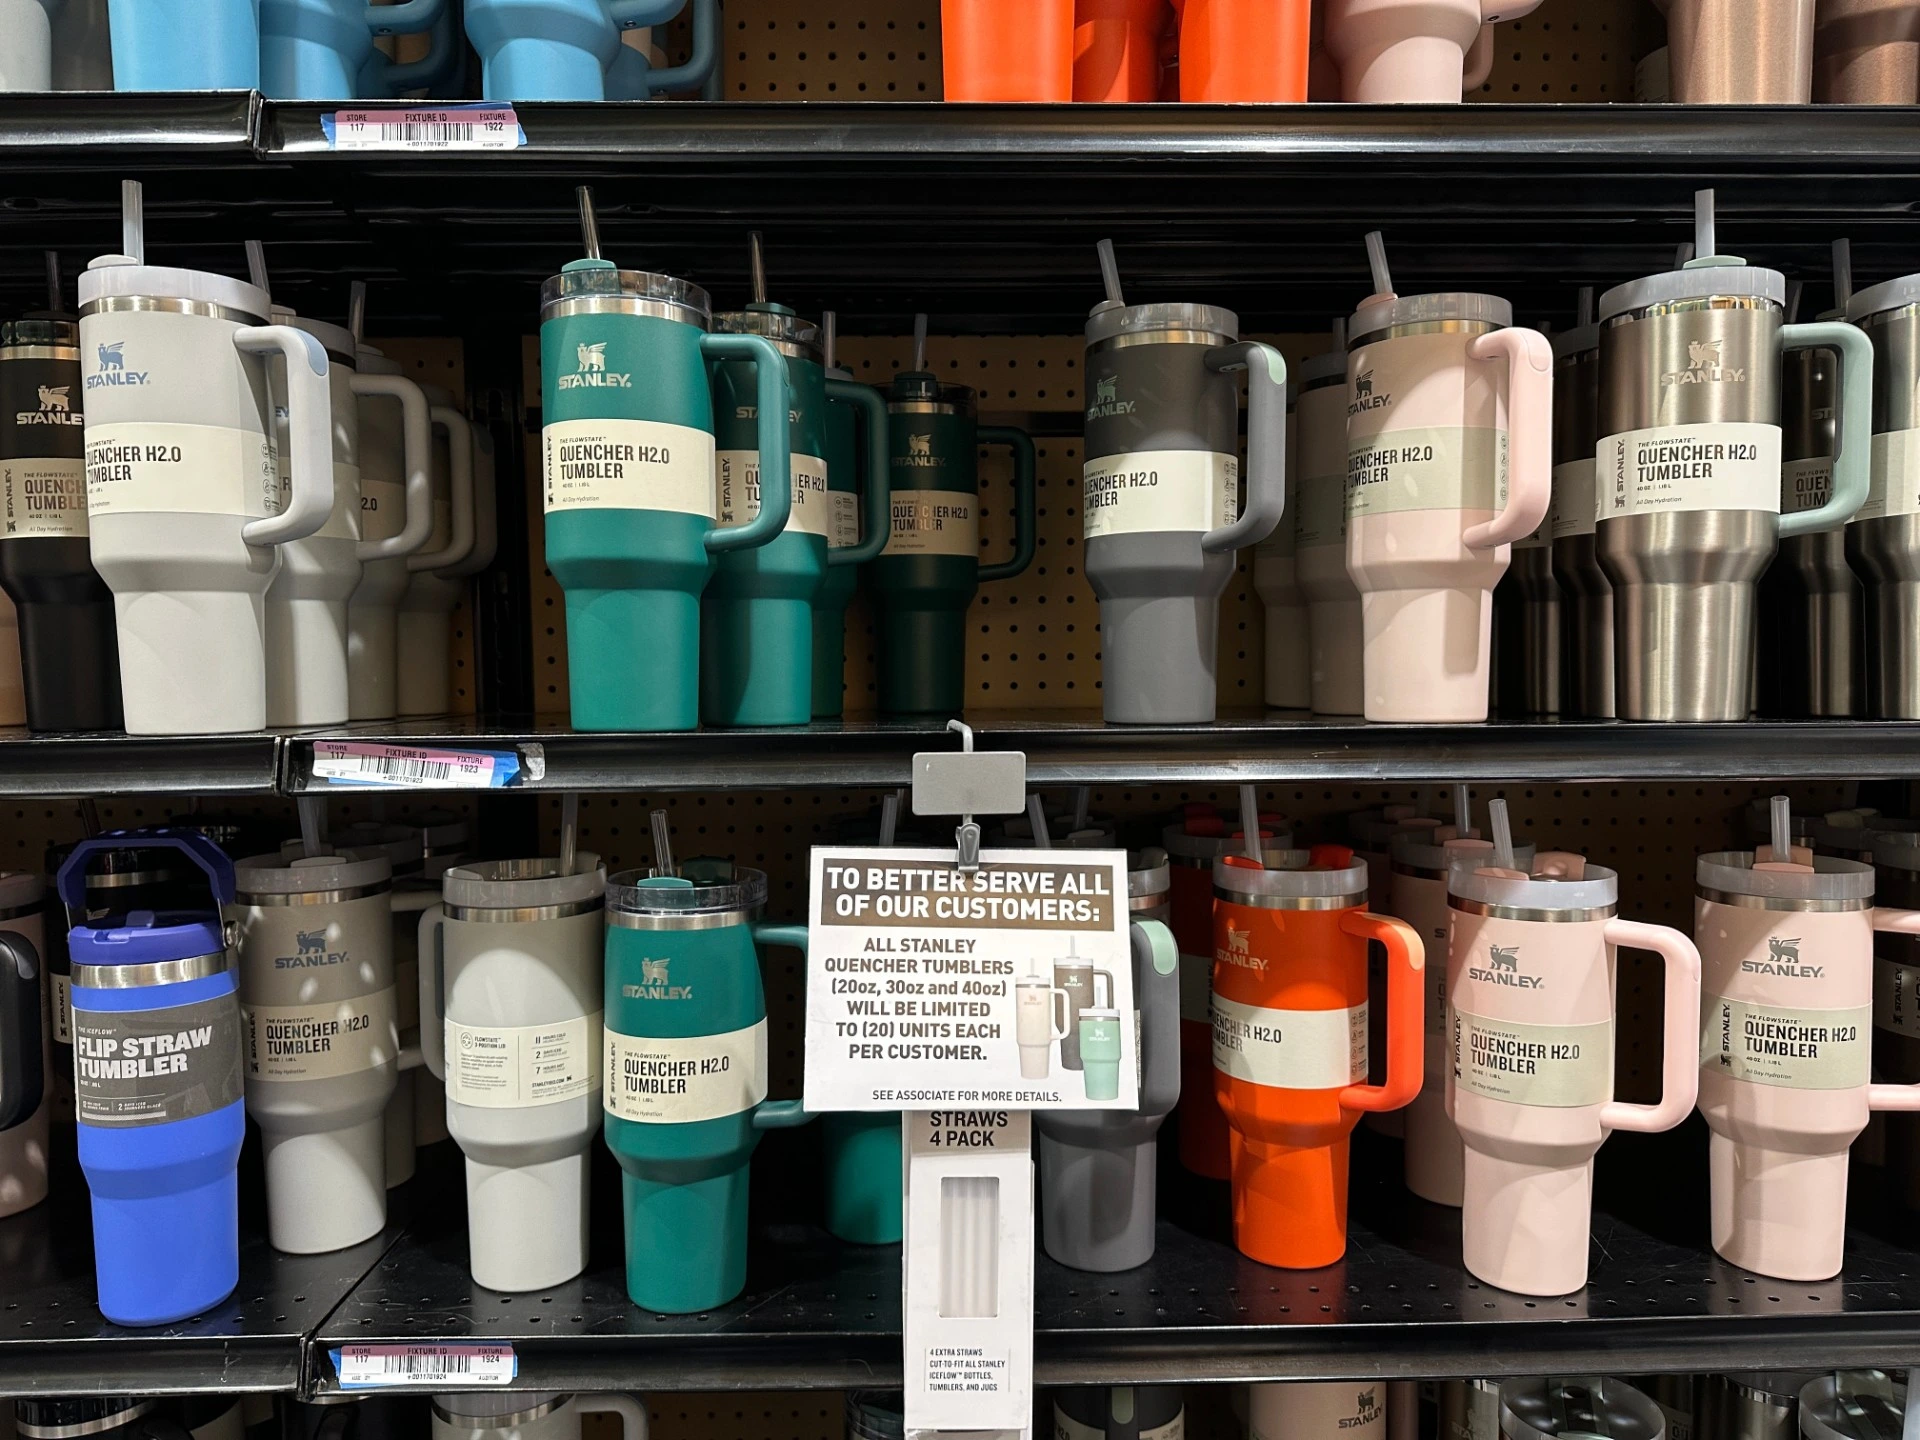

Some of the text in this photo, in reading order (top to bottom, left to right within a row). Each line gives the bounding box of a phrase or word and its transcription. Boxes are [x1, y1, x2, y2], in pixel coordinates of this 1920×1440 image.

[484, 123, 503, 131] 1922
[146, 446, 181, 462] H2.0
[560, 445, 669, 464] QUENCHER H2.0
[1402, 446, 1432, 462] H2.0
[1638, 444, 1756, 465] QUENCHER H2.0
[561, 463, 623, 480] TUMBLER
[1130, 471, 1157, 487] H2.0
[1638, 462, 1712, 483] TUMBLER
[25, 480, 86, 494] QUENCH
[25, 496, 86, 510] TUMBLE
[361, 498, 377, 511] 2.0
[386, 749, 417, 758] FIXTURE
[457, 756, 483, 764] FIXTURE
[460, 765, 478, 773] 1923
[827, 867, 1110, 896] TO BETTER SERVE ALL
[836, 894, 1100, 922] OF OUR CUSTOMERS:
[864, 938, 976, 953] ALL STANLEY
[825, 958, 1014, 975] QUENCHER TUMBLERS
[832, 979, 1006, 997] (20oz, 30oz and 40oz)
[847, 1001, 990, 1017] WILL BE LIMITED
[266, 1015, 369, 1039] QUENCHER H2.0
[836, 1022, 1001, 1039] TO (20) UNITS EACH
[1254, 1026, 1281, 1043] H2.0
[1745, 1021, 1856, 1042] QUENCHER H2.0
[79, 1026, 212, 1058] FLIP STRAW
[267, 1038, 330, 1054] TUMBLER
[1471, 1033, 1580, 1060] QUENCHER H2.0
[1744, 1036, 1817, 1058] TUMBLER
[536, 1051, 540, 1059] 2
[849, 1045, 988, 1060] PER CUSTOMER.
[79, 1053, 188, 1079] TUMBLER
[625, 1056, 729, 1076] QUENCHER H2.0
[1471, 1050, 1535, 1075] TUMBLER
[624, 1075, 686, 1094] TUMBLER
[872, 1090, 1062, 1102] SEE ASSOCIATE FOR MORE DETAILS.
[930, 1111, 1008, 1128] STRAWS
[930, 1131, 995, 1147] 4 PACK
[355, 1355, 368, 1363] 117
[929, 1360, 1005, 1368] CUT-TO-FIT ALL STANLEY
[964, 1372, 993, 1380] BOTTLES,
[929, 1383, 964, 1392] TUMBLERS,
